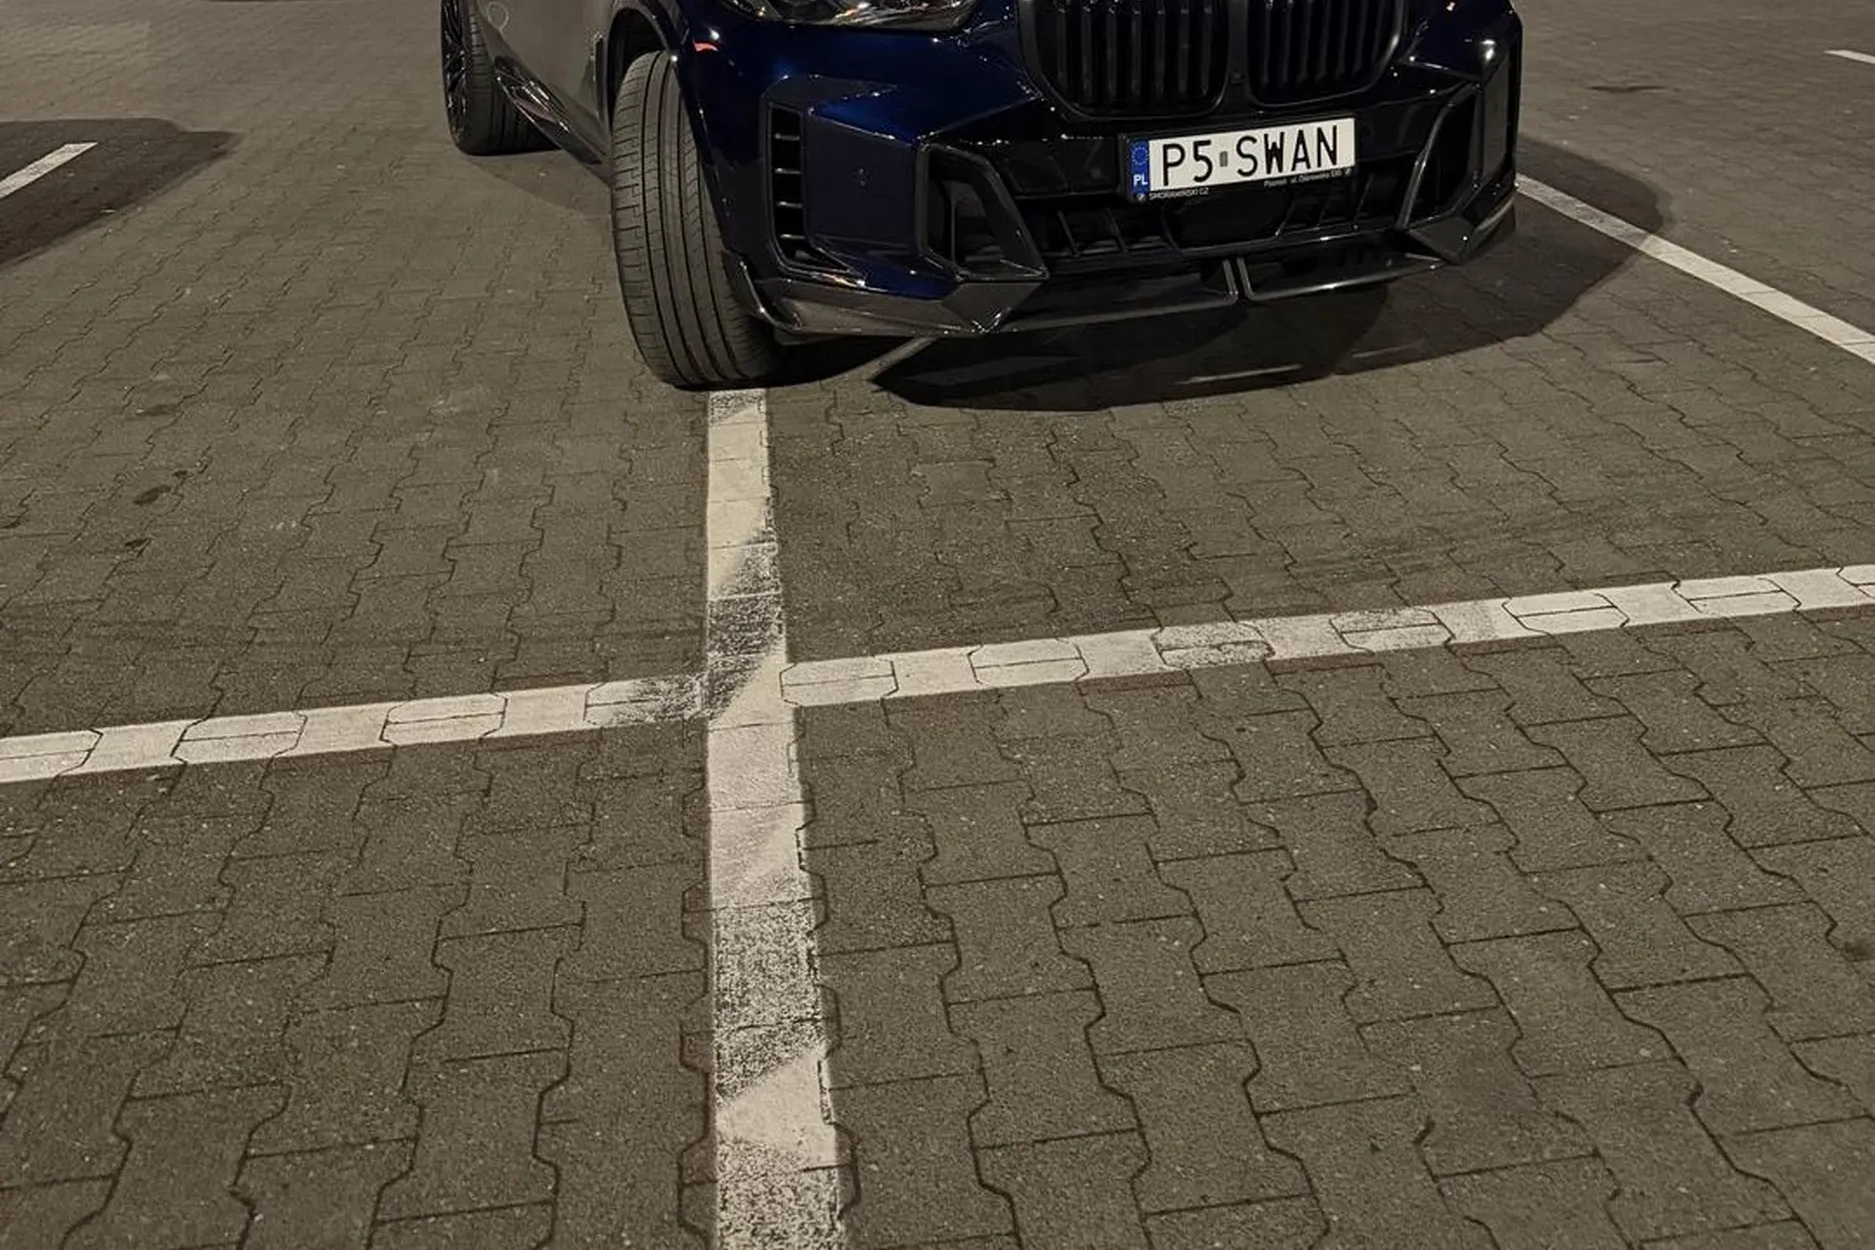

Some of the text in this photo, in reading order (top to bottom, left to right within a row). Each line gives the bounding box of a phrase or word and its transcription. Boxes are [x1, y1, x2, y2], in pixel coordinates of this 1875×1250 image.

[1162, 125, 1338, 186] P5 SWAN
[1133, 174, 1148, 186] PL
